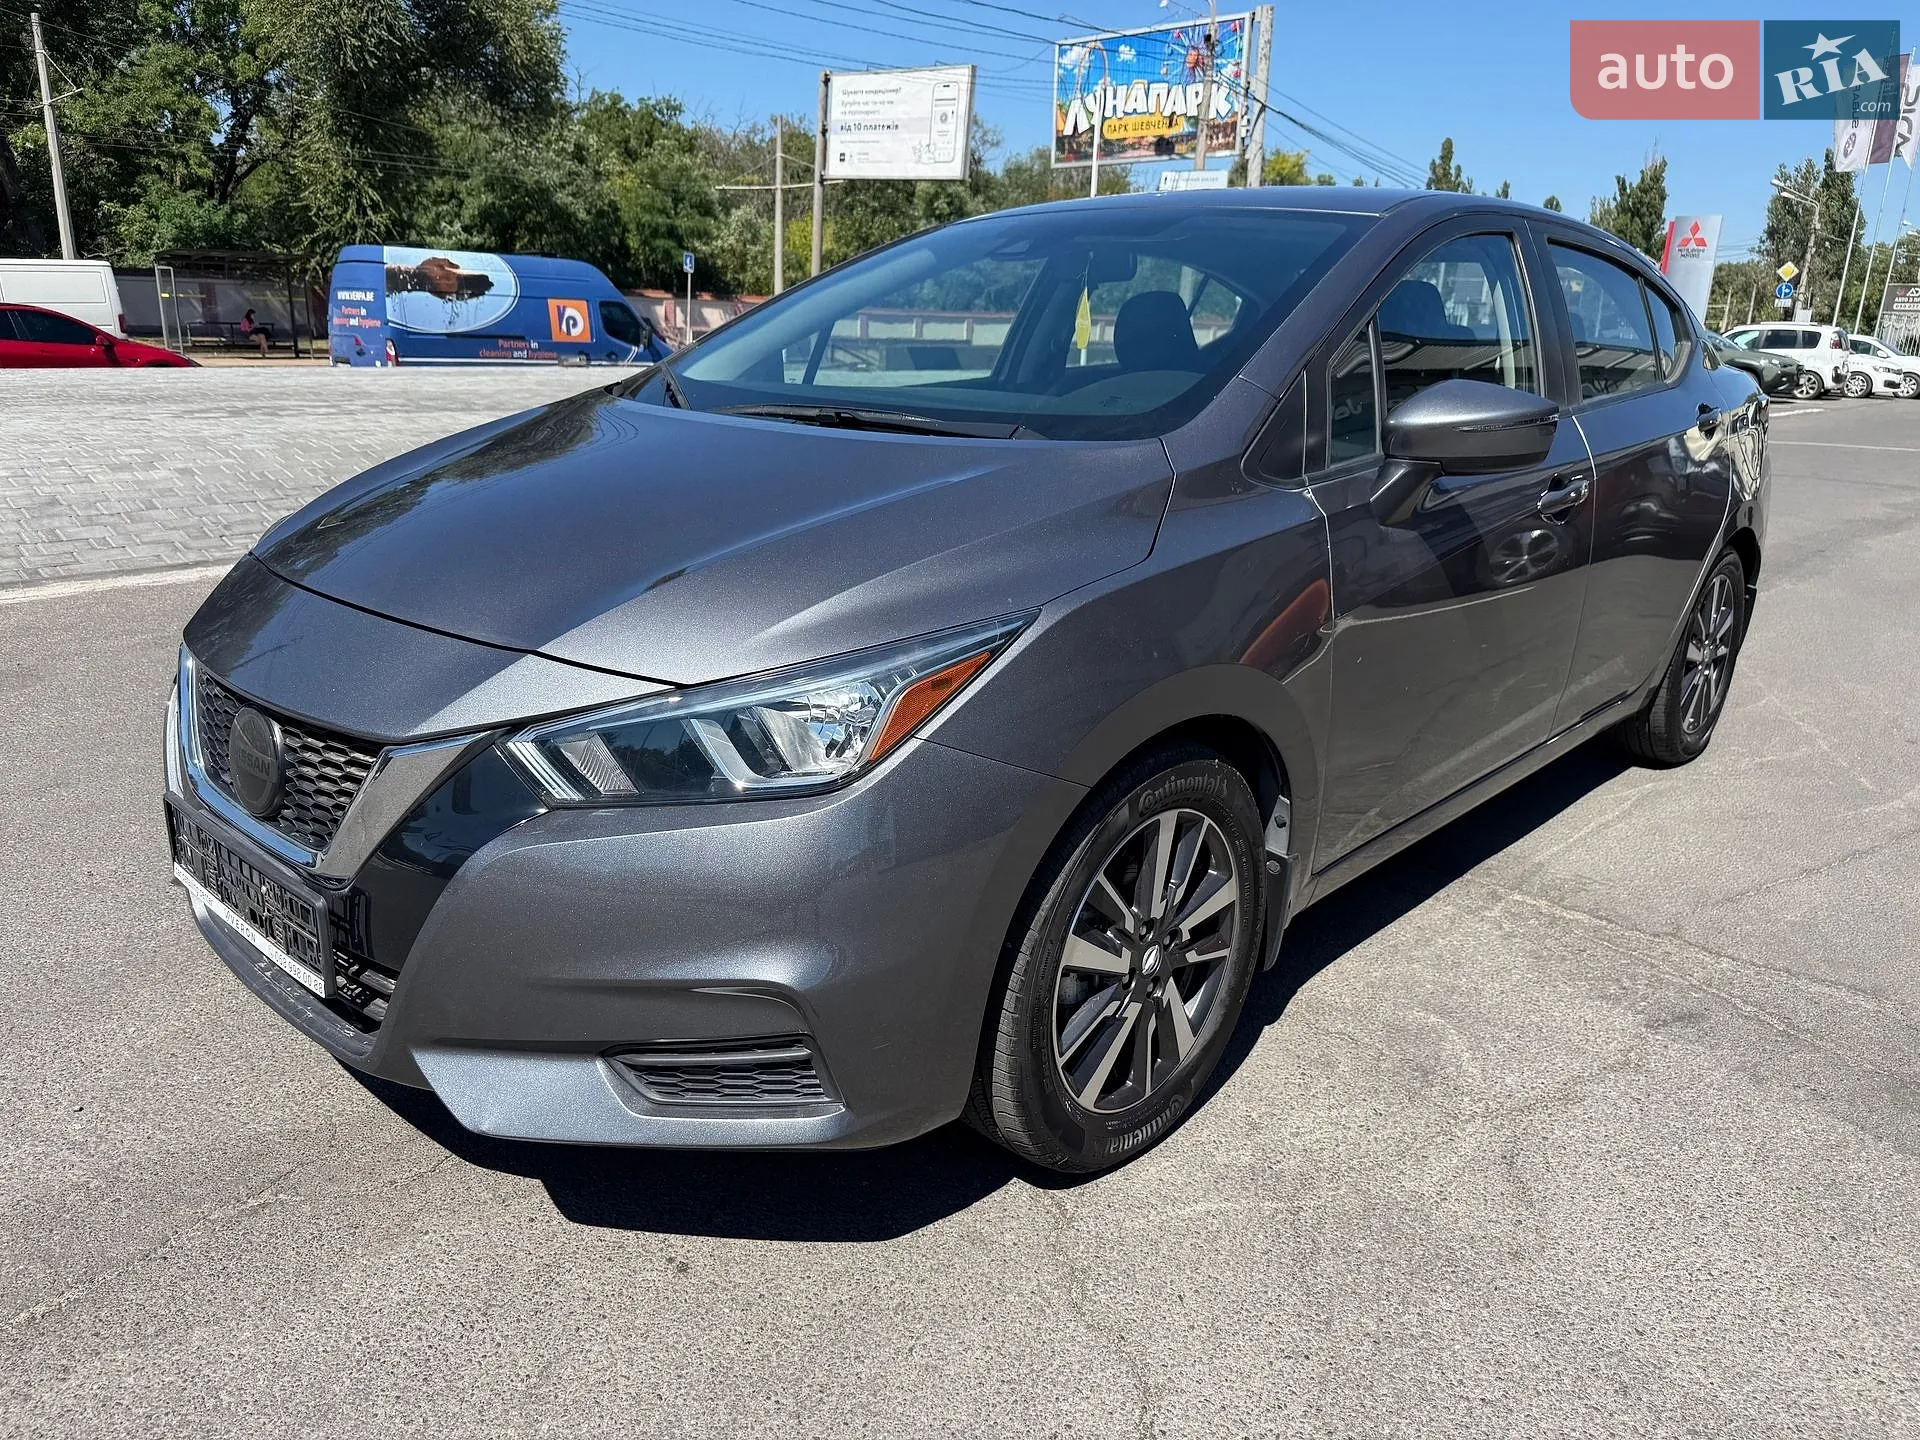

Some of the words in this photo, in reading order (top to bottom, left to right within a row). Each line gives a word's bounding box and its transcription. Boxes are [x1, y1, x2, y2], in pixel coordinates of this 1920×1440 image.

[1063, 80, 1234, 136] ЛУНАПАРК
[841, 122, 851, 132] від
[853, 122, 862, 131] 10
[863, 120, 899, 131] платежів
[1106, 122, 1129, 135] ПАРК
[1131, 119, 1179, 132] ШЕВЧЕНА
[349, 316, 359, 326] and
[498, 339, 529, 348] Partners
[530, 339, 539, 349] in
[479, 347, 512, 358] cleaning
[513, 349, 527, 358] and
[1138, 775, 1220, 816] Continental
